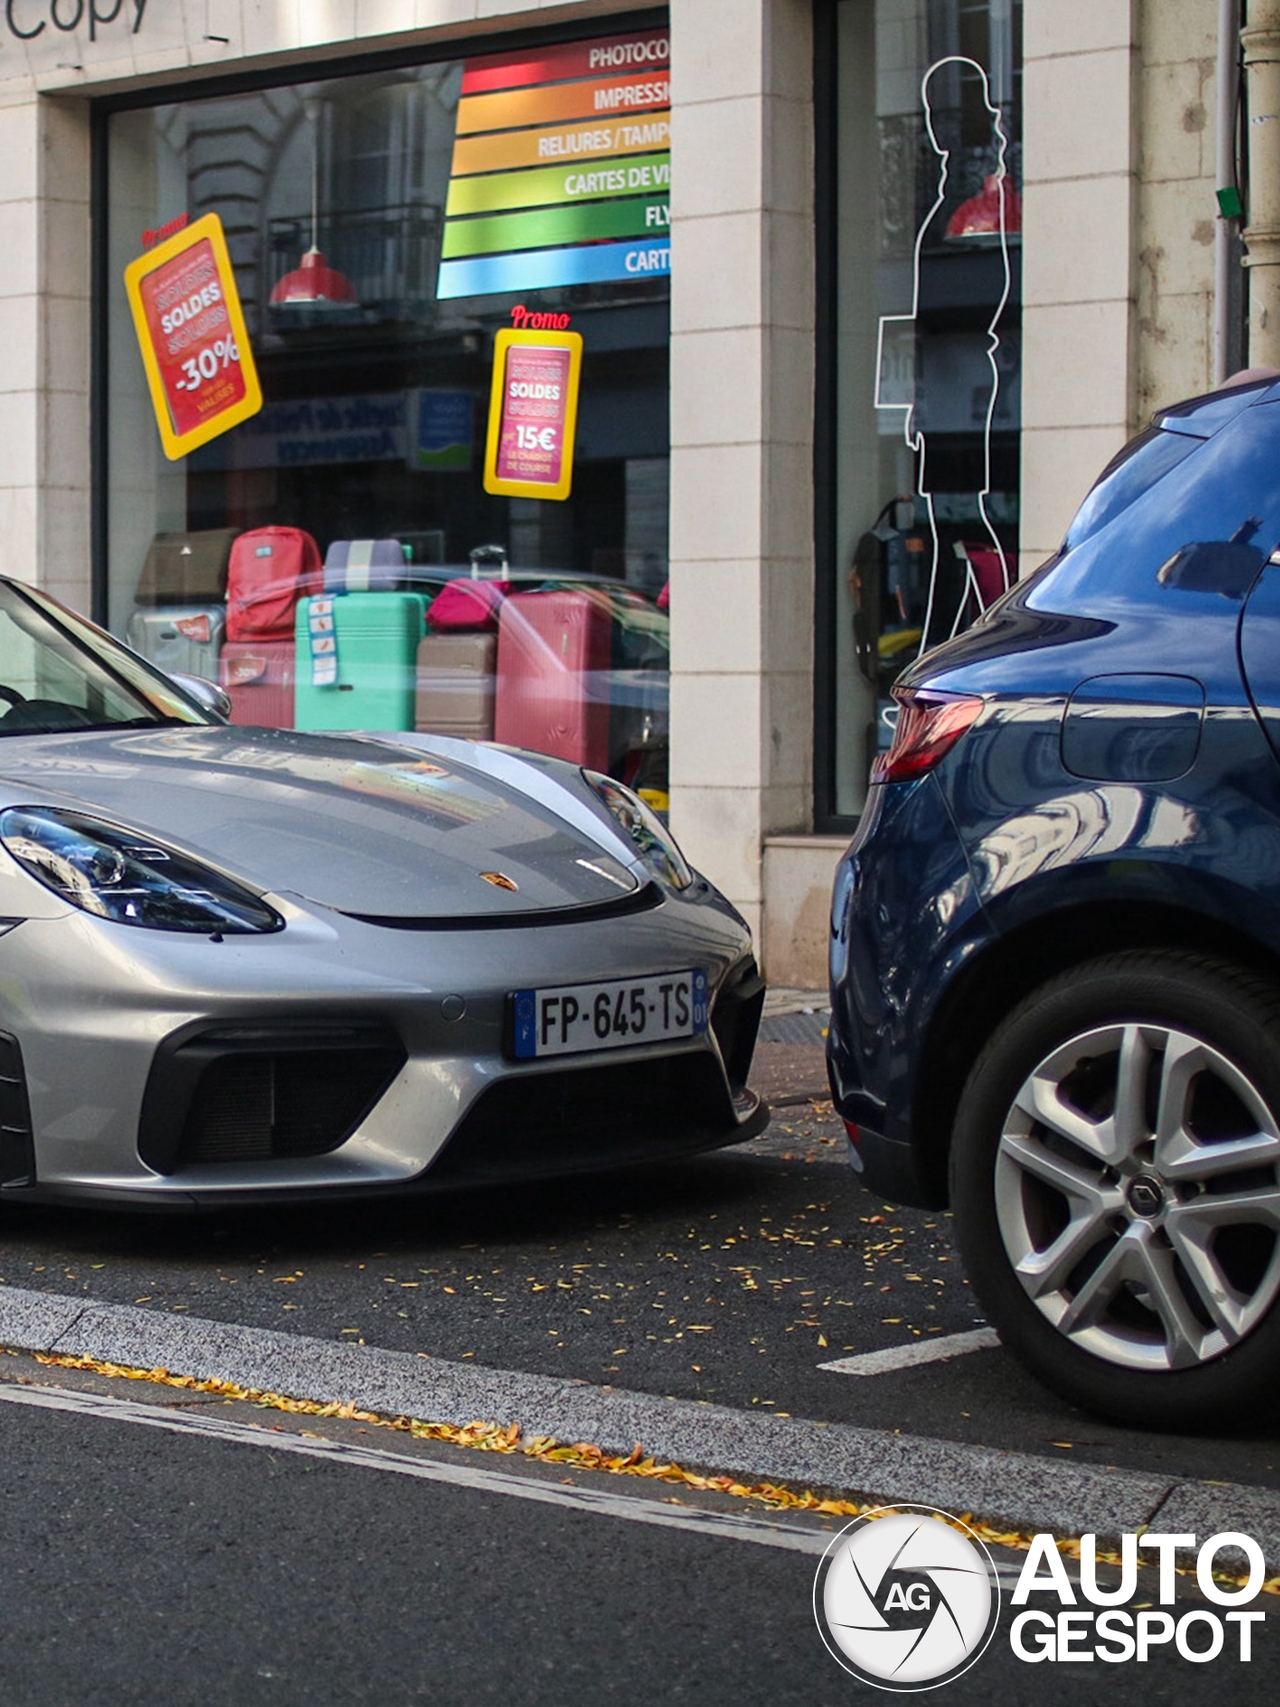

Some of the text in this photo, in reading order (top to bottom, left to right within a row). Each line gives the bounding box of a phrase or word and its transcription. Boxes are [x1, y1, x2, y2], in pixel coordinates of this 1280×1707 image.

[6, 0, 147, 42] Copy
[588, 39, 670, 69] PHOTOCO
[593, 81, 670, 110] IMPRESSI
[538, 128, 612, 158] RELIURES
[621, 121, 670, 146] TAMP
[564, 169, 626, 196] CARTES
[627, 166, 651, 188] DE
[141, 212, 189, 250] Promo
[624, 248, 670, 273] CART
[160, 281, 221, 336] SOLDES
[510, 304, 570, 330] Promo
[175, 332, 240, 392] -30%
[509, 381, 561, 401] SOLDES
[515, 425, 558, 451] 15€
[541, 982, 690, 1046] FP-645-TS
